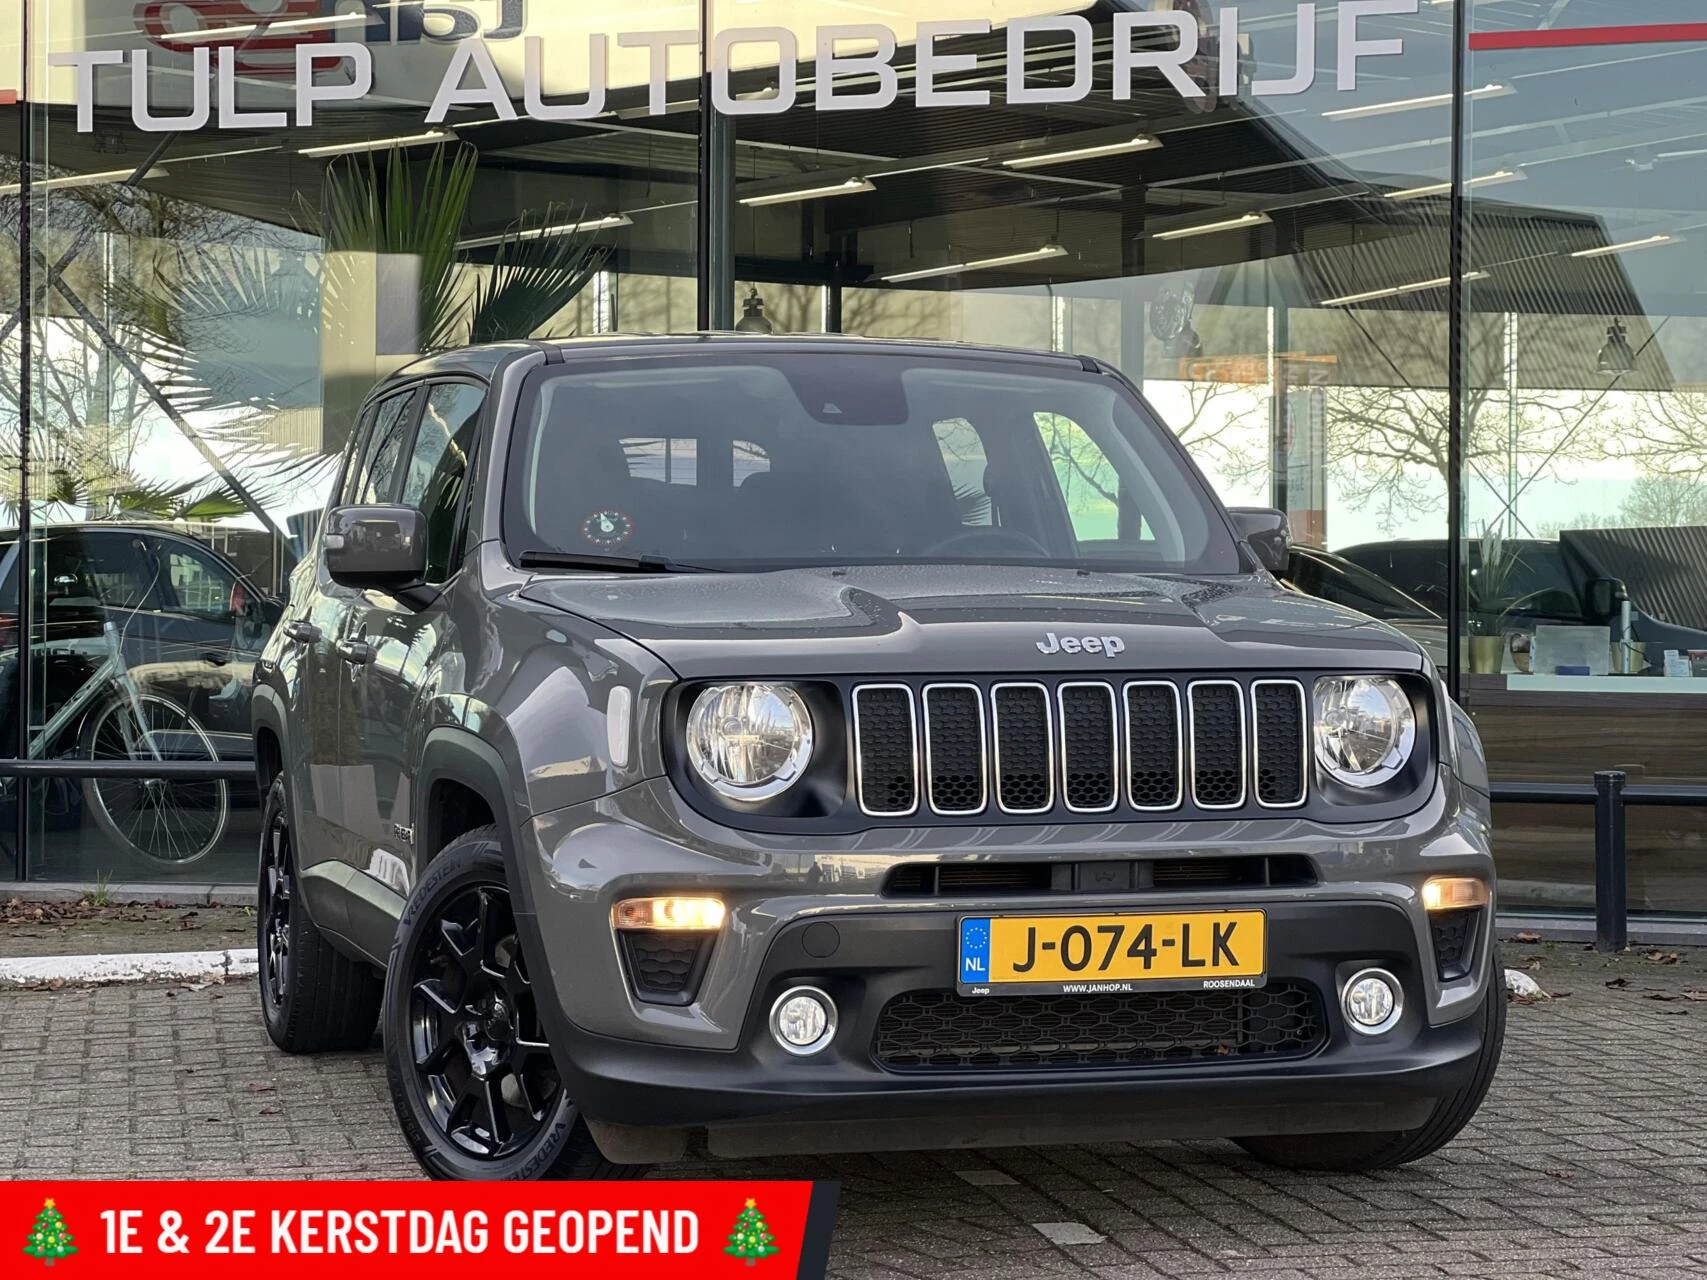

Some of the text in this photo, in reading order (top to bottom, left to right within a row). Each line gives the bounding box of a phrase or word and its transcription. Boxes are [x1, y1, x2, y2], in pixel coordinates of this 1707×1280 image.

[48, 0, 1418, 133] TULP AUTOBEDRIJF
[1036, 632, 1125, 657] Jeep
[1012, 921, 1240, 973] J-074-LK
[965, 958, 985, 972] NL
[1063, 983, 1133, 993] WWW.JANHOP.NL
[1203, 979, 1256, 989] ROOSENDAAL
[971, 987, 990, 996] Jeep
